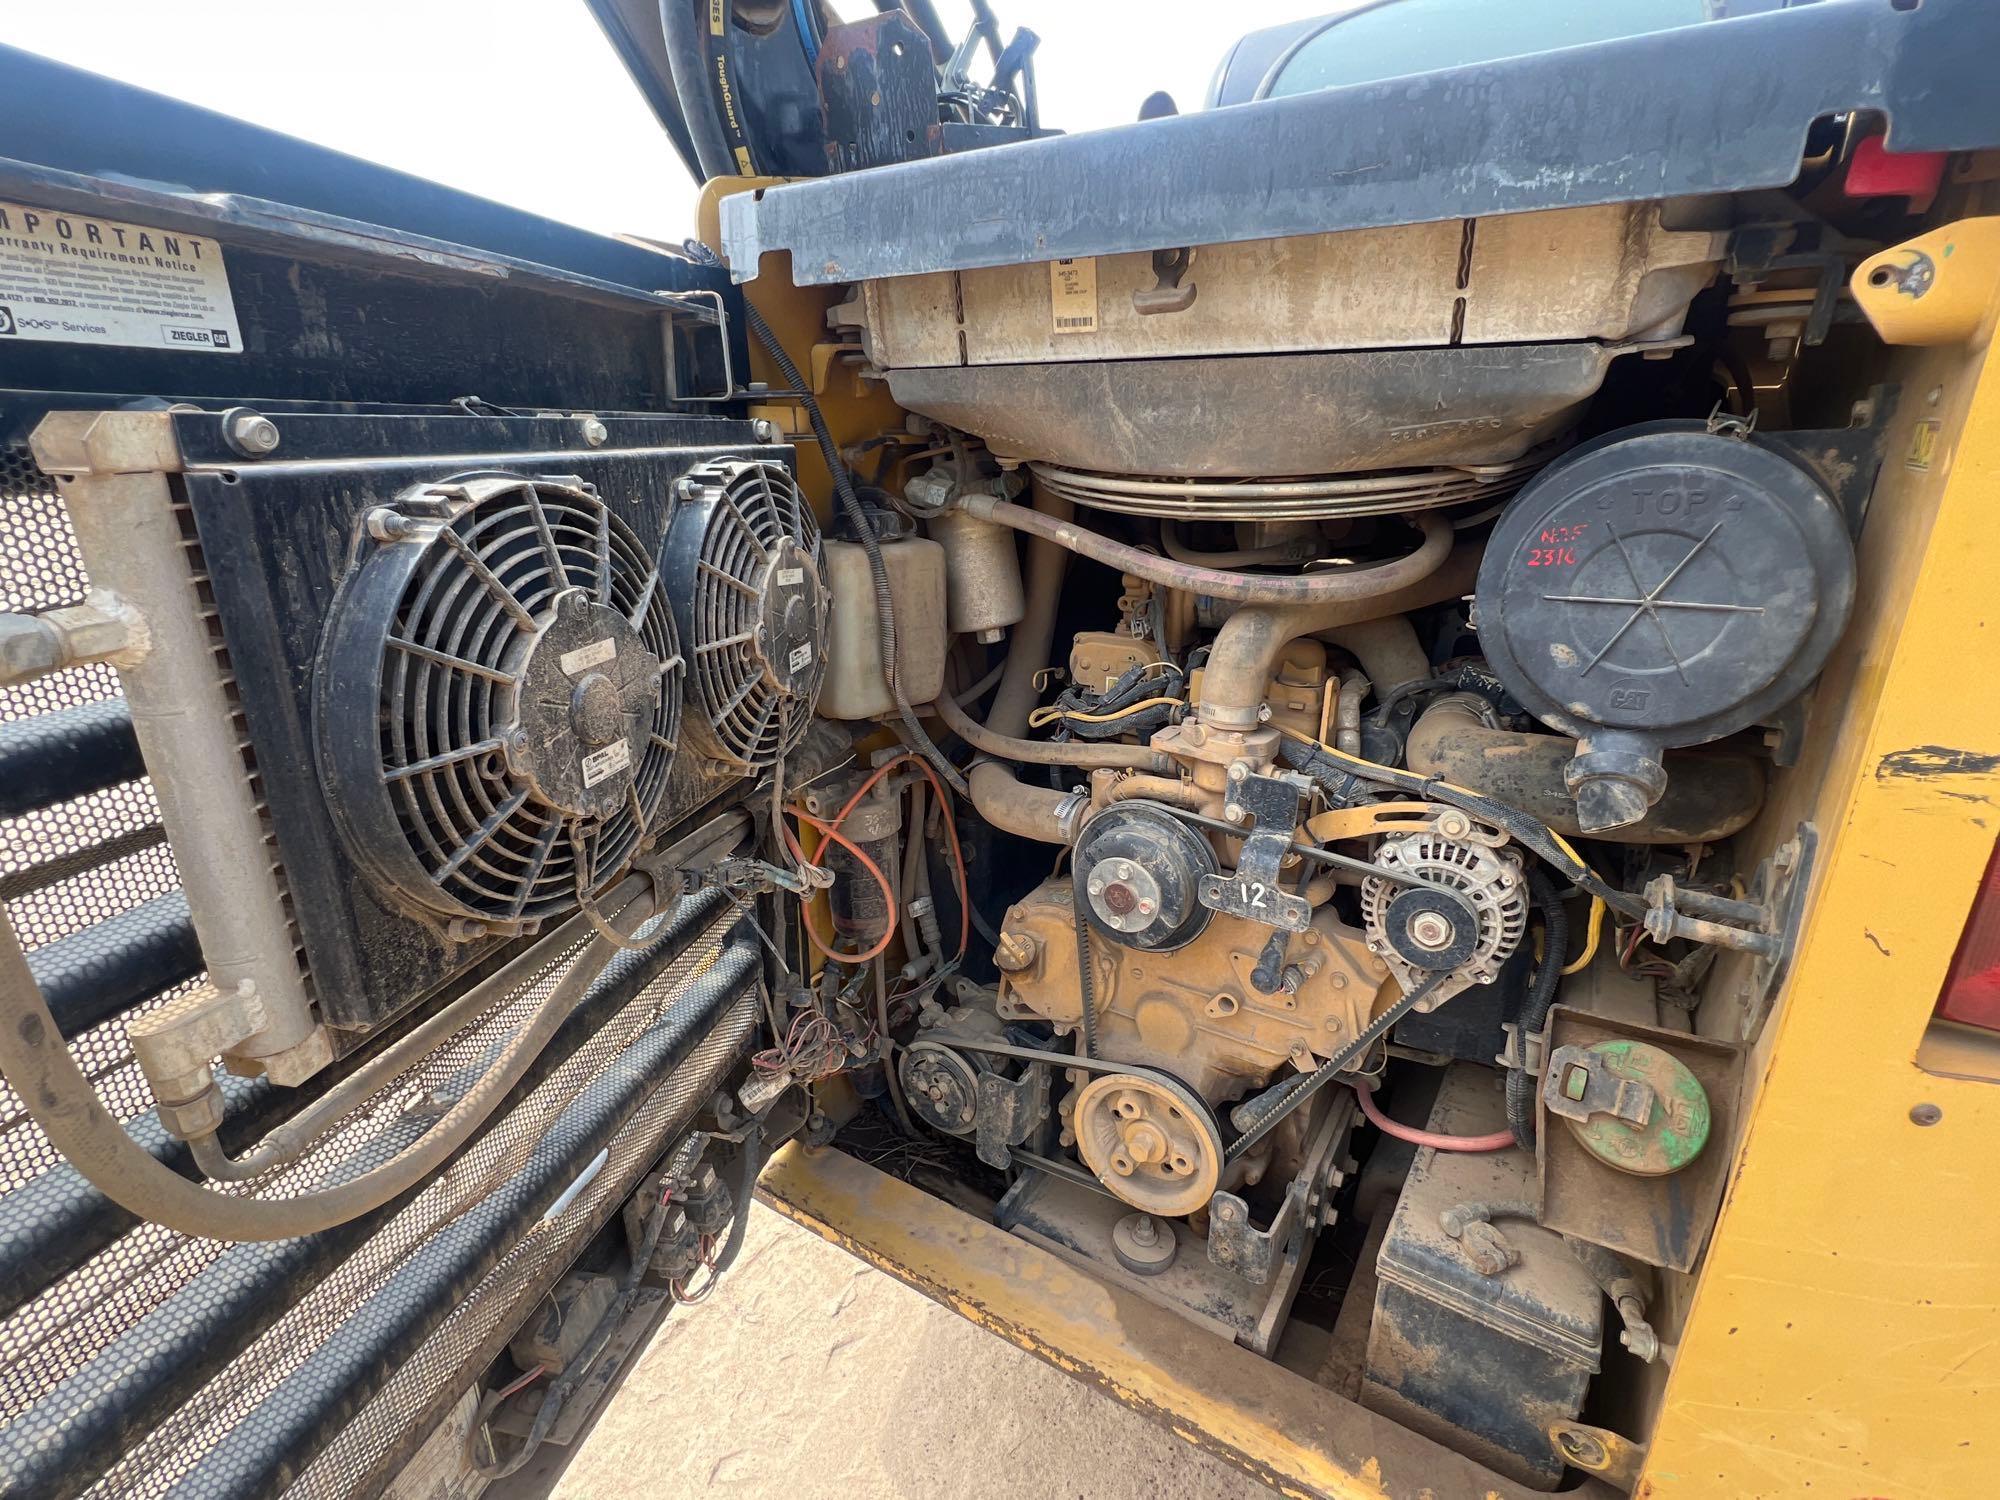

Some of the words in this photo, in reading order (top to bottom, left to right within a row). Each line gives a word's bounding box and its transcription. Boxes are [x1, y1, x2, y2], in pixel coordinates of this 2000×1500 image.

[60, 242, 151, 266] Requirement
[155, 256, 197, 272] Notice
[62, 321, 106, 334] Services
[171, 330, 210, 342] ZIEGLER
[1632, 489, 1708, 515] TOP
[1241, 882, 1267, 908] 12
